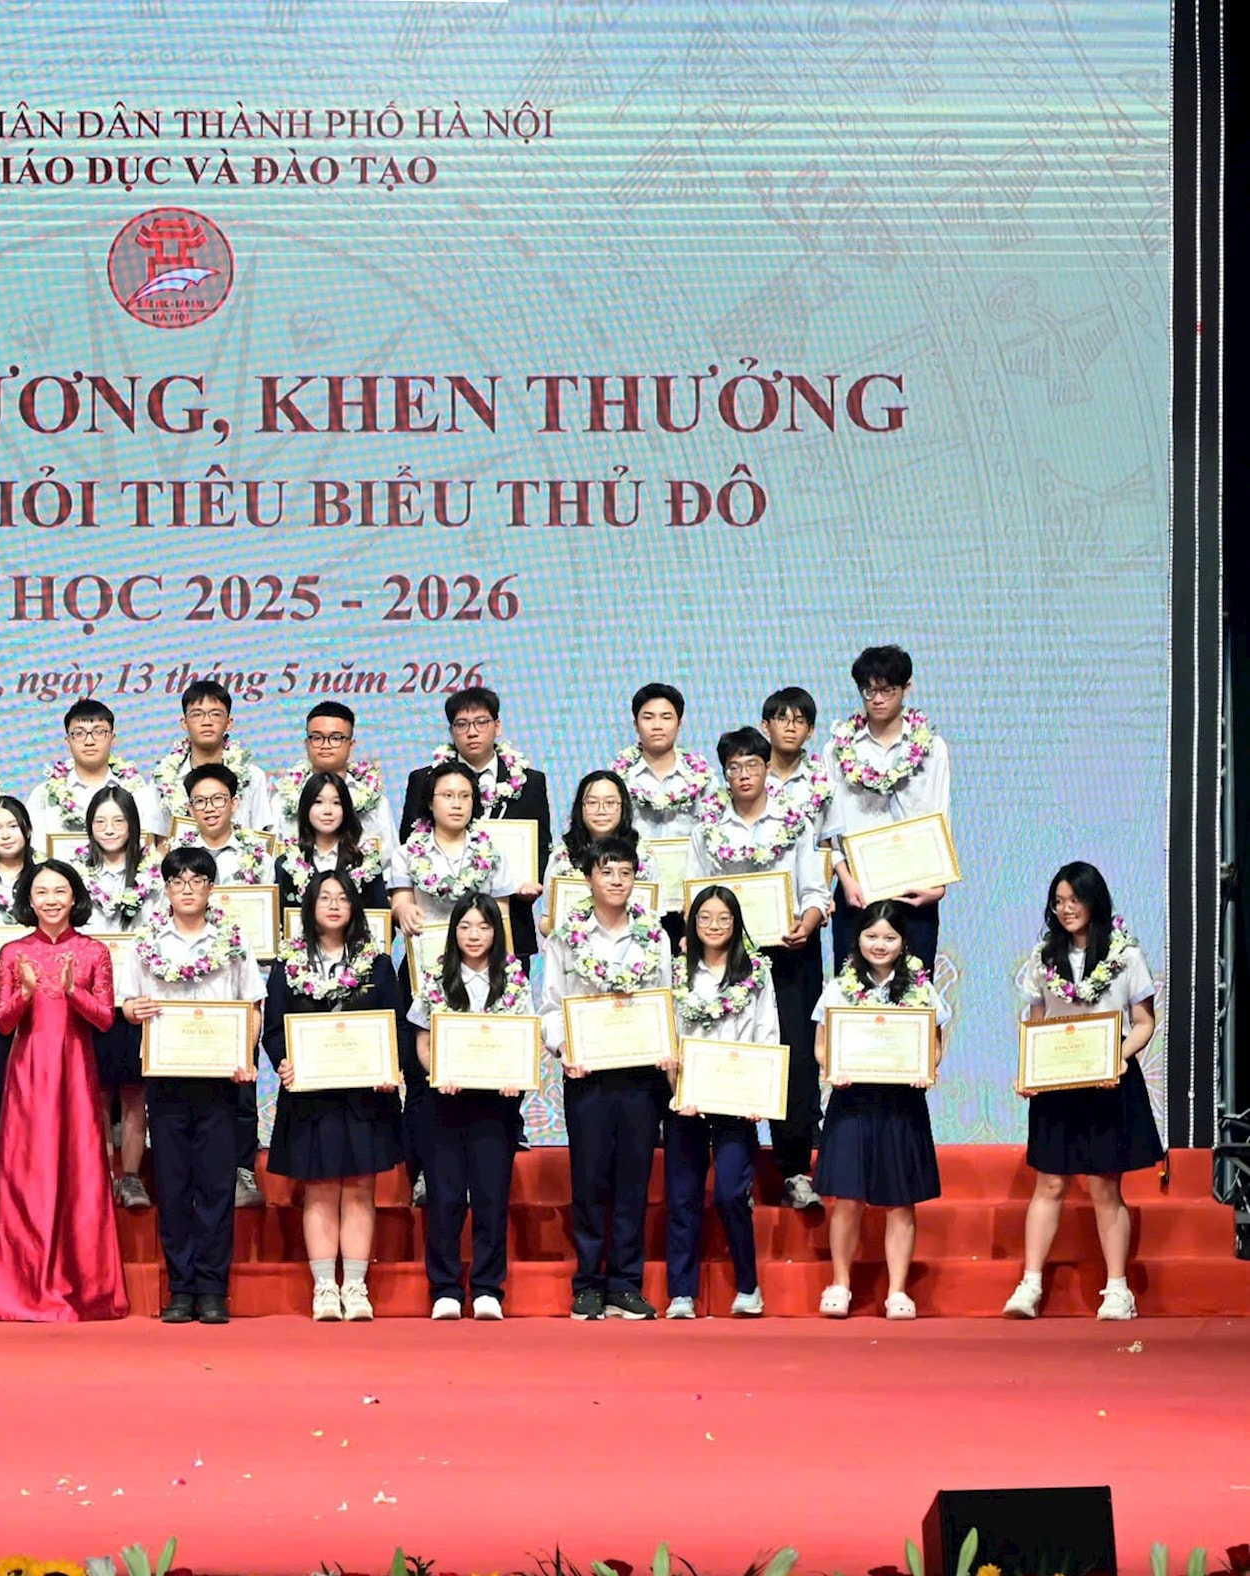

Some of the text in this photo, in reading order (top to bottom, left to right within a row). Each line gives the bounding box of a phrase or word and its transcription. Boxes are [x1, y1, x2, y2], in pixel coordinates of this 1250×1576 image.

[76, 100, 162, 139] DÂN
[173, 101, 313, 139] THÀNH
[325, 100, 405, 139] PHỐ
[416, 101, 472, 139] HÀ
[483, 101, 554, 145] NỘI
[86, 157, 172, 193] DỤC
[184, 148, 240, 185] VÀ
[252, 148, 339, 184] ĐÀO
[351, 157, 436, 191] TẠO
[253, 374, 503, 434] KHEN
[526, 357, 908, 433] THƯỞNG
[119, 463, 288, 528] TIÊU
[308, 464, 475, 528] BIỂU
[496, 464, 644, 528] THỦ
[664, 463, 768, 528] ĐÔ
[9, 574, 164, 636] HỌC
[185, 575, 320, 621] 2025
[341, 600, 362, 608] -
[383, 575, 518, 621] 2026
[17, 662, 103, 702] ngày
[114, 662, 154, 694] 13
[278, 663, 299, 693] 5
[309, 661, 388, 694] năm
[397, 661, 485, 693] 2026
